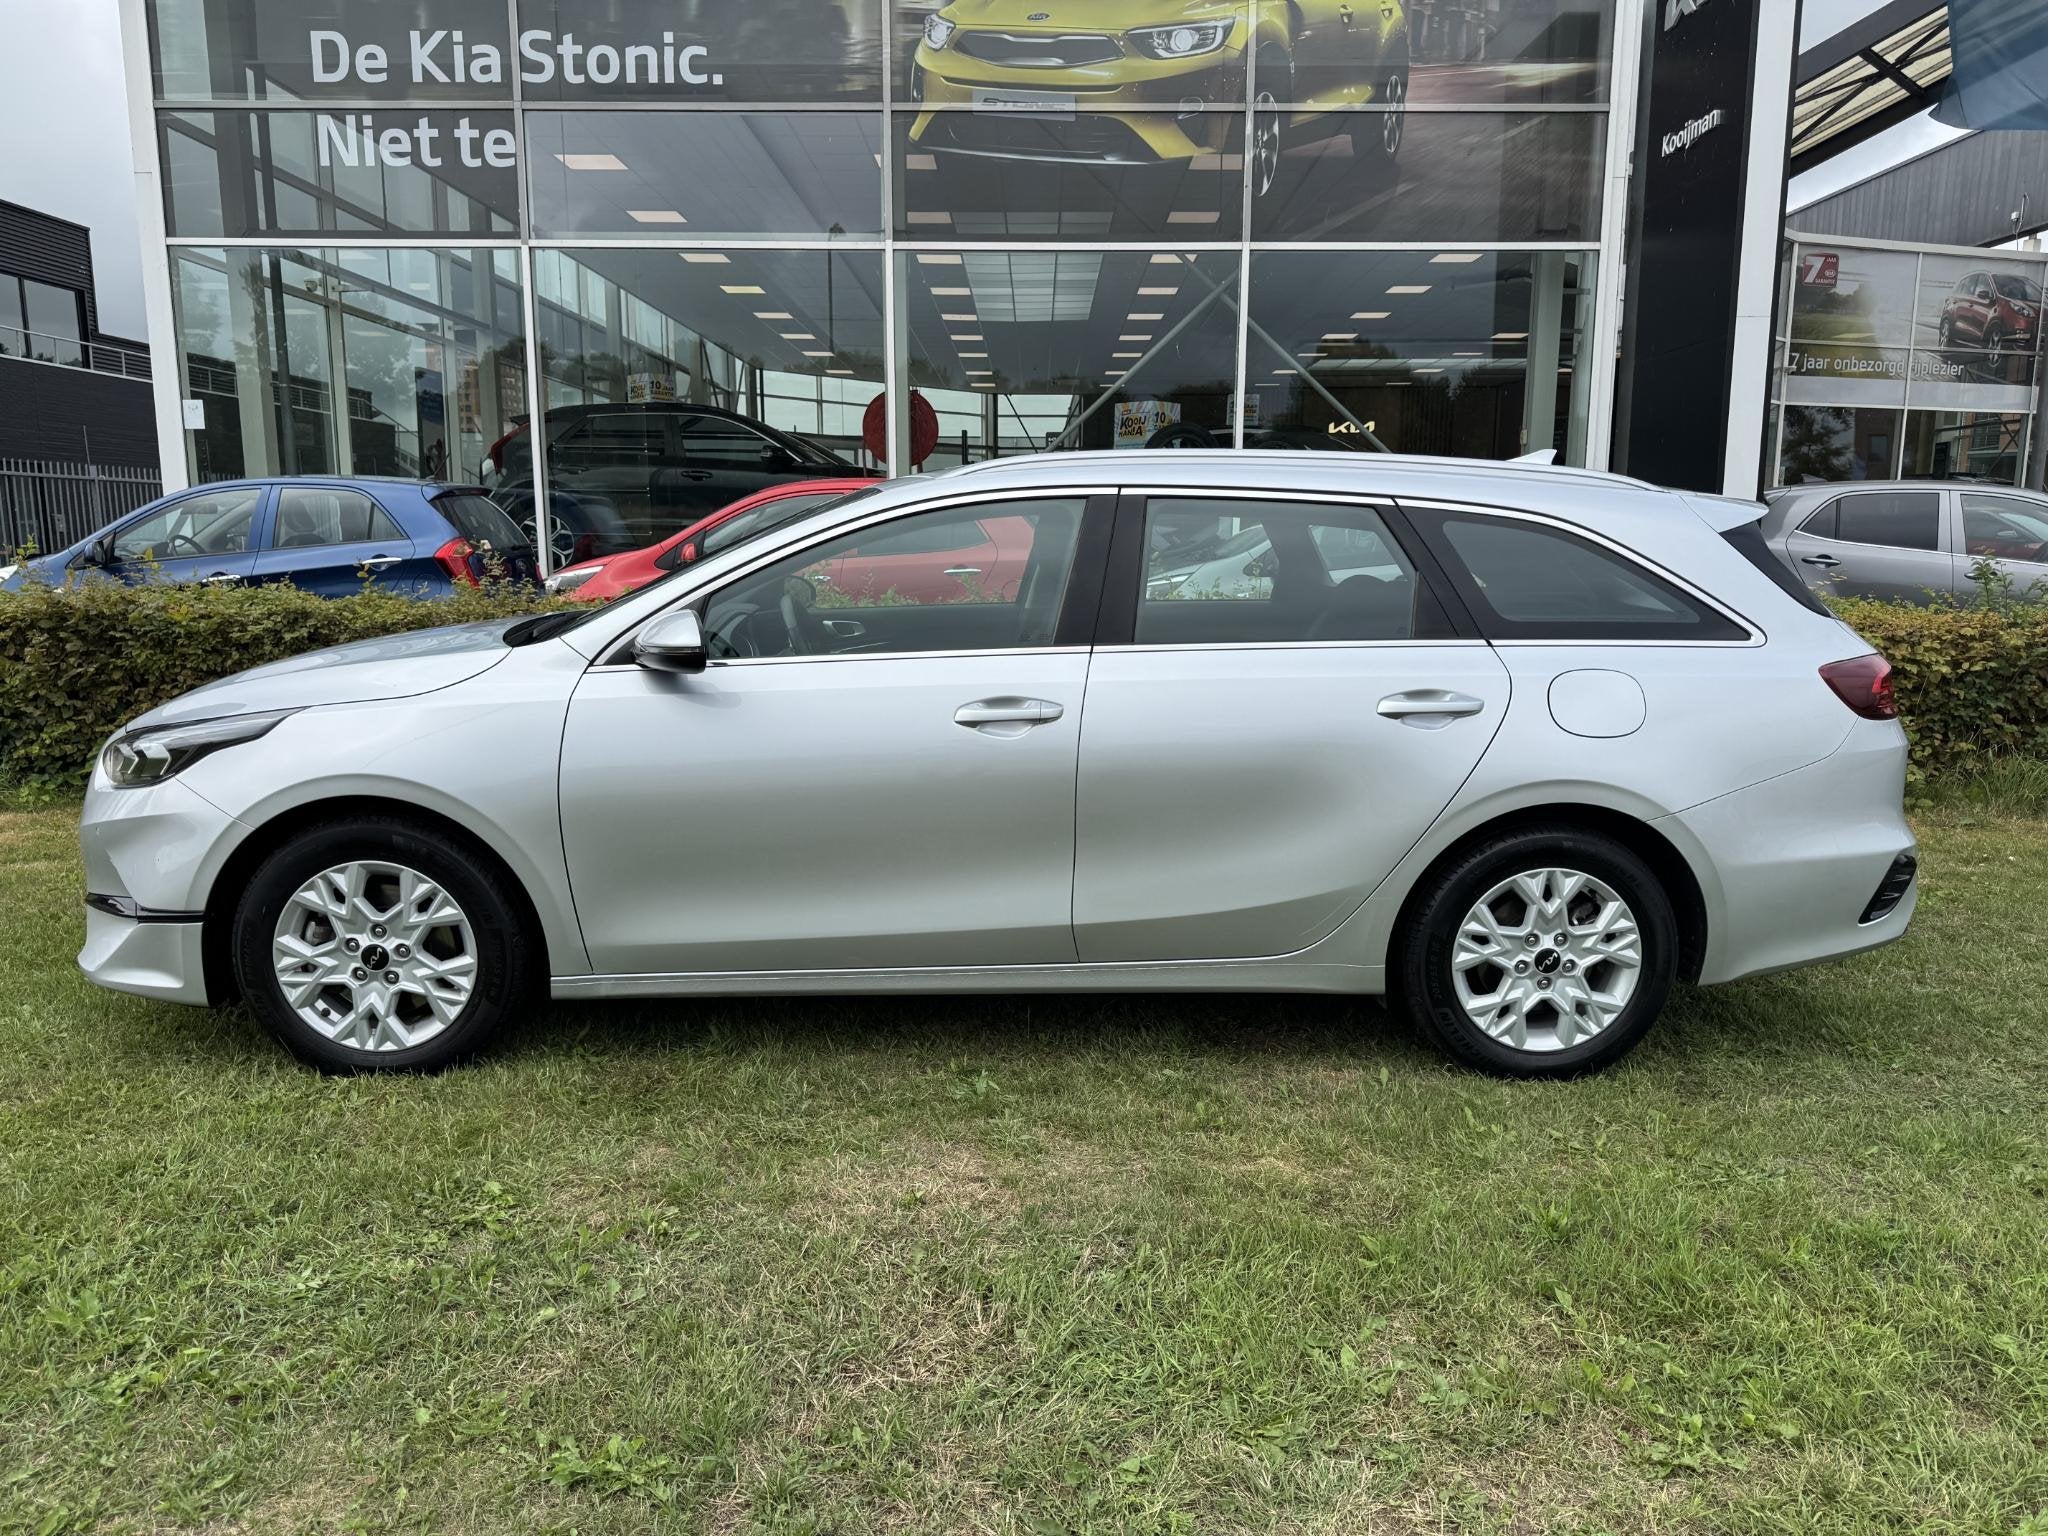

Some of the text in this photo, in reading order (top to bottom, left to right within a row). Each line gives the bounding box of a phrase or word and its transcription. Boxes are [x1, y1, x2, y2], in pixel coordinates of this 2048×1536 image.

[310, 29, 724, 85] De Kia Stonic.
[316, 114, 517, 168] Niet te
[1661, 109, 1721, 157] Kooijman
[1791, 353, 1800, 366] 7
[1801, 354, 1831, 372] jaar
[1834, 356, 1906, 376] onbezorgd
[1120, 415, 1147, 430] KOOIJ
